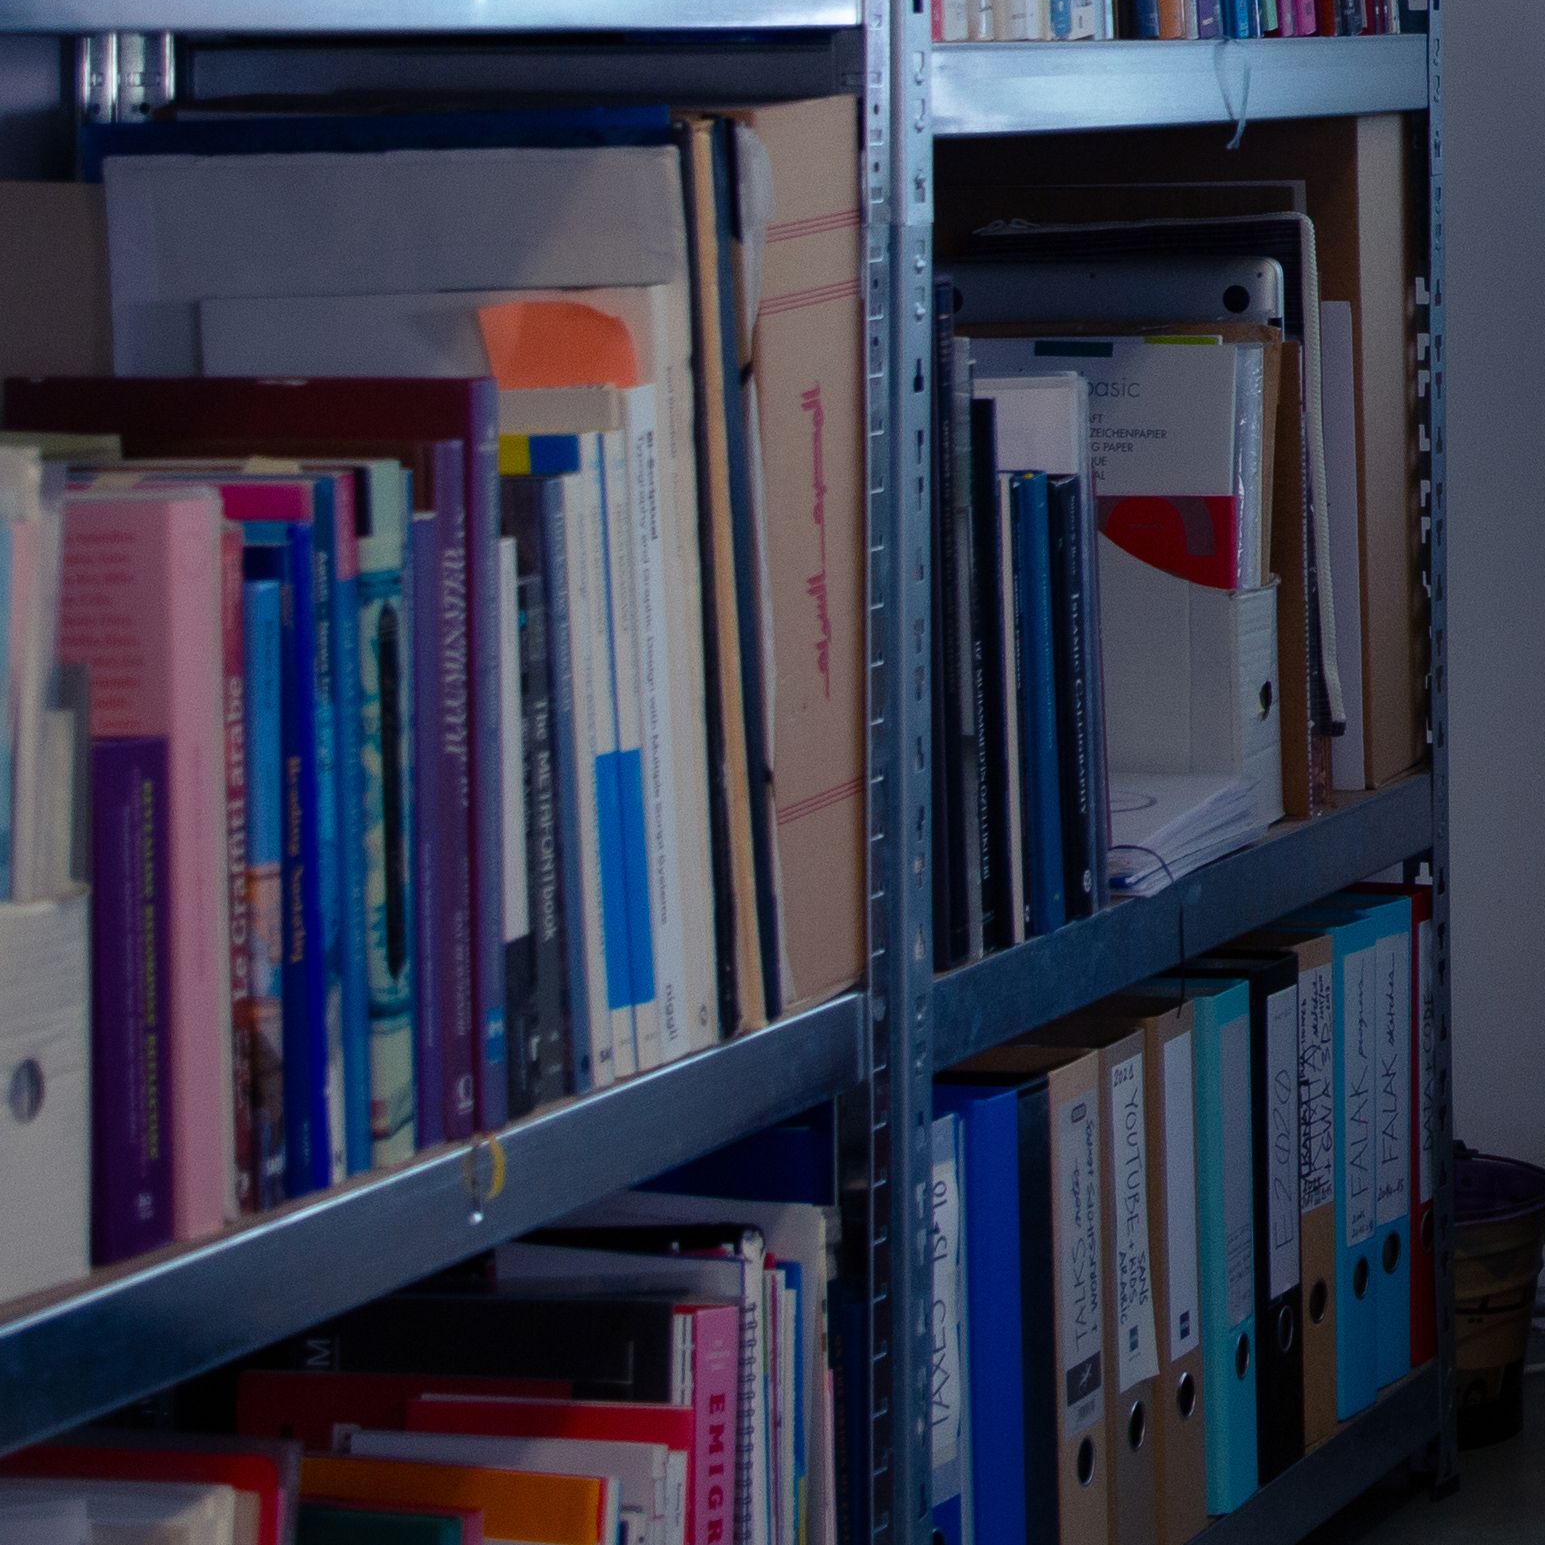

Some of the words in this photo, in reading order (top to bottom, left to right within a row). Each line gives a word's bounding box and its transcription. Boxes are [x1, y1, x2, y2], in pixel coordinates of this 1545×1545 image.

[1090, 428, 1168, 438] ZEICHENPAPIER
[1103, 443, 1134, 452] PAPER
[635, 436, 648, 528] Typography
[640, 534, 649, 565] and
[641, 567, 651, 631] Graphic
[645, 634, 655, 691] Design
[225, 673, 245, 795] arabe
[533, 698, 549, 741] The
[648, 696, 657, 730] with
[651, 732, 660, 798] Multiple
[533, 749, 560, 943] METAFONTbook
[654, 801, 663, 850] Script
[225, 796, 250, 938] Graffiti
[656, 853, 667, 925] Systems
[229, 939, 251, 1001] Le
[1385, 951, 1396, 1047] sketches
[663, 982, 681, 1043] niggli
[1421, 992, 1434, 1054] CODE
[1349, 1065, 1369, 1198] FALAK
[1380, 1054, 1399, 1165] FALAK
[1421, 1085, 1434, 1151] DATA
[1124, 1087, 1141, 1236] YOUTUBE
[1085, 1181, 1099, 1313] WORKSHOPS
[1128, 1257, 1139, 1301] KIDS
[1138, 1252, 1149, 1306] SANS
[1071, 1237, 1088, 1353] TALKS
[1118, 1250, 1131, 1326] ARABIC
[932, 1300, 950, 1431] TAXES
